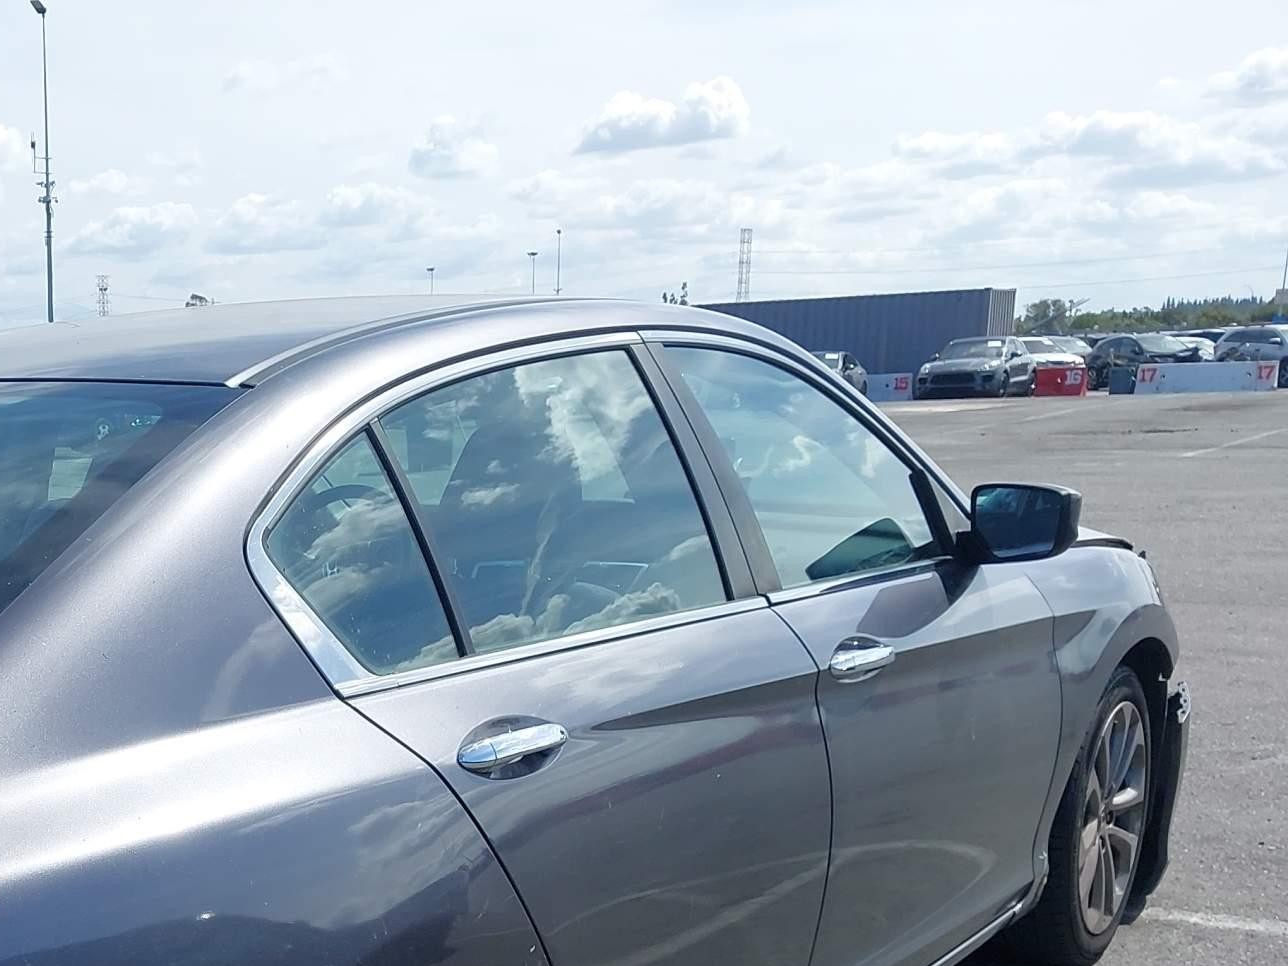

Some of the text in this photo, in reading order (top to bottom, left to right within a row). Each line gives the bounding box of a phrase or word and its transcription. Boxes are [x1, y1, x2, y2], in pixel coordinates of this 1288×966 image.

[1065, 370, 1083, 385] 16
[1139, 368, 1158, 383] 17
[1257, 365, 1276, 380] 17
[894, 376, 909, 391] 15
